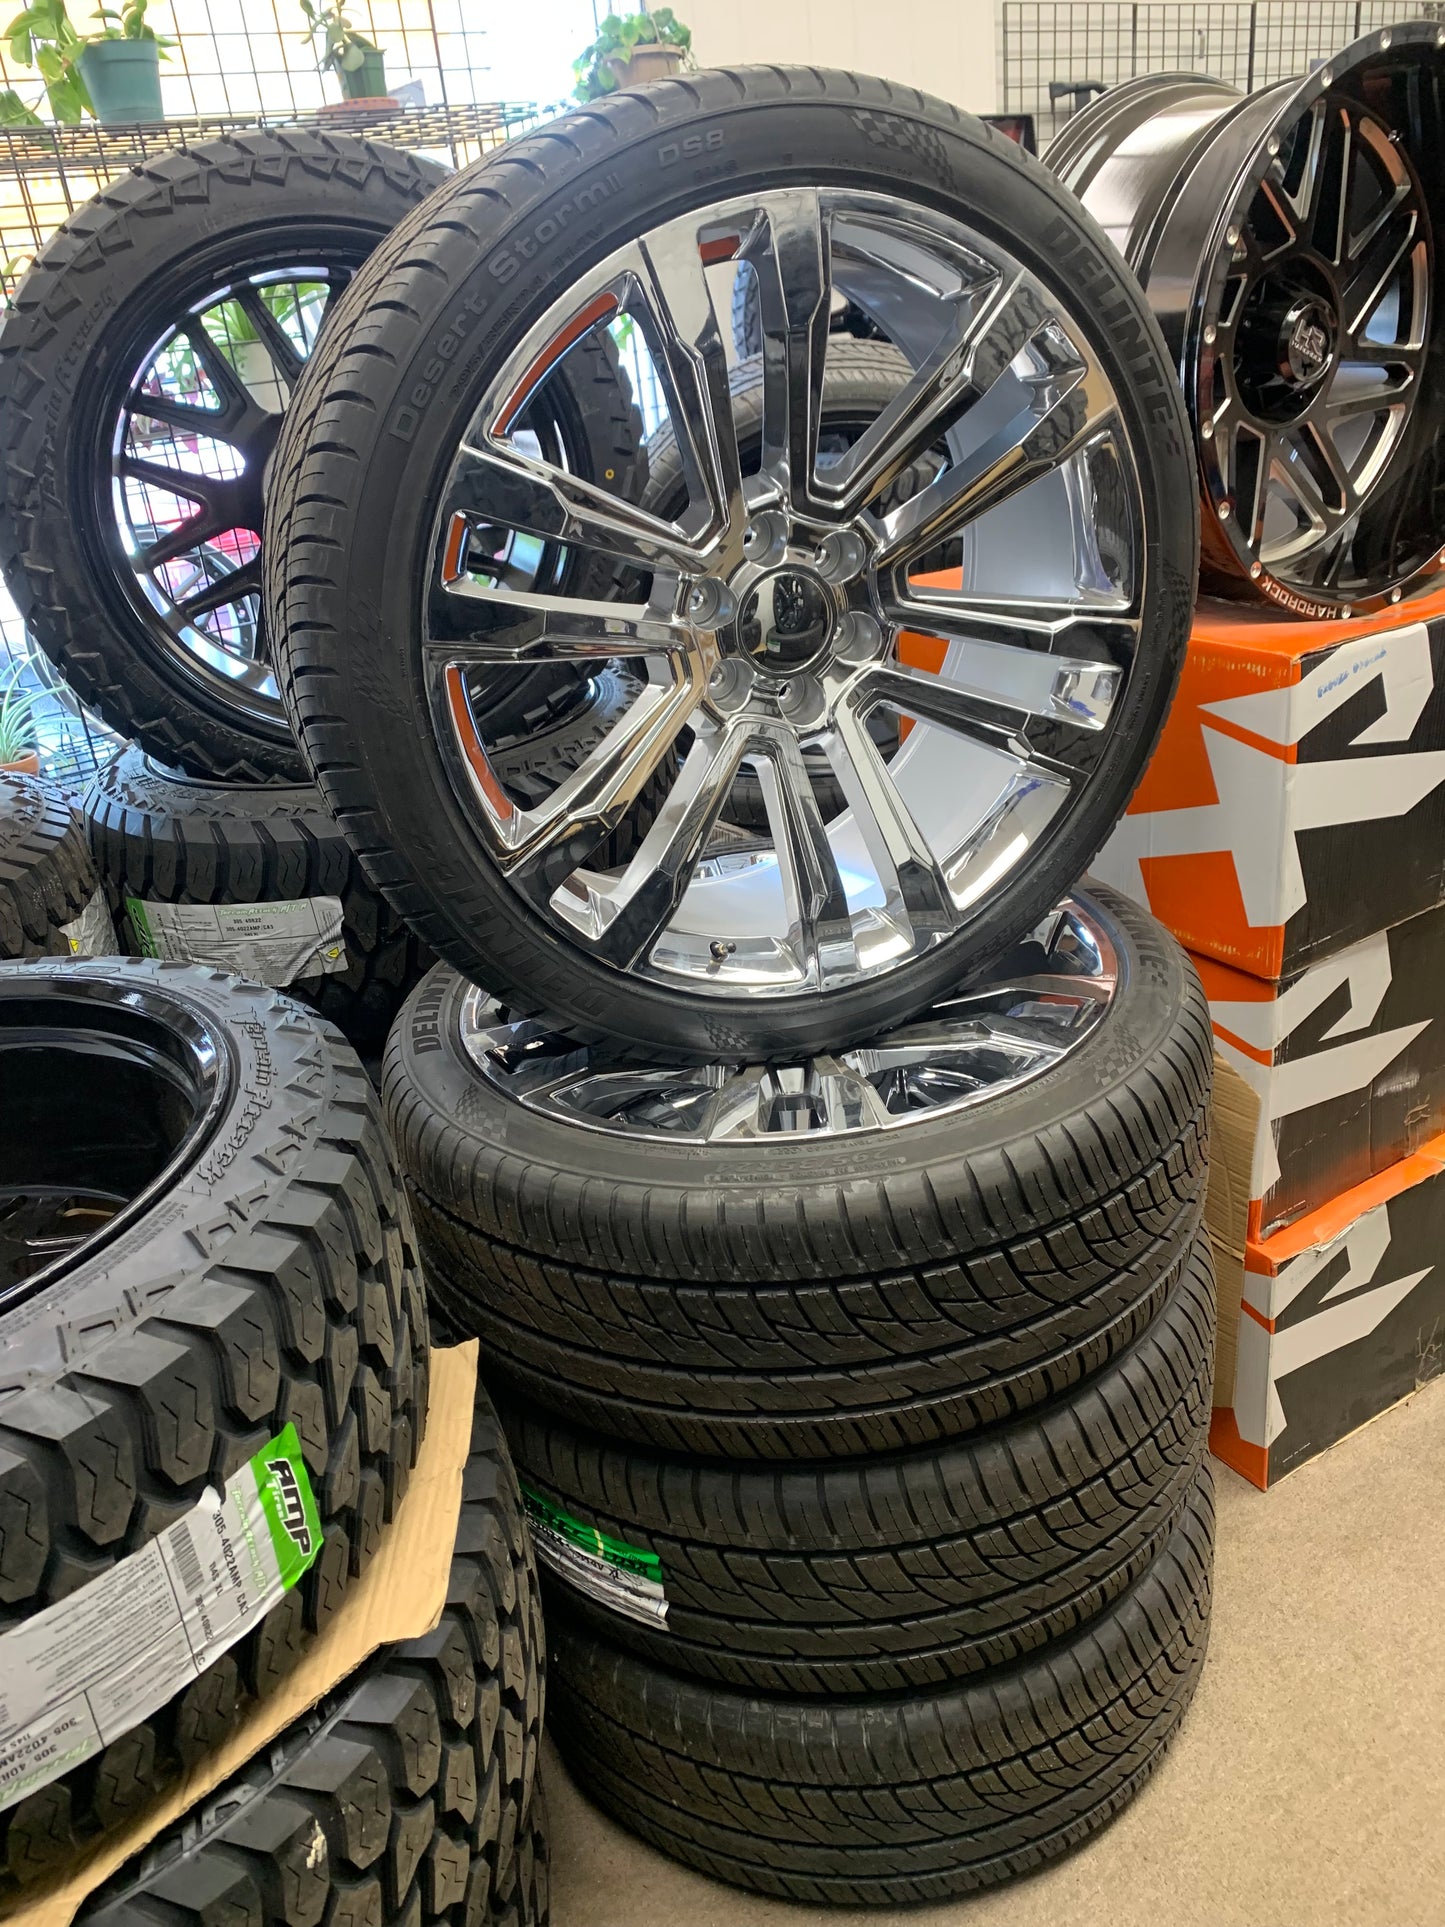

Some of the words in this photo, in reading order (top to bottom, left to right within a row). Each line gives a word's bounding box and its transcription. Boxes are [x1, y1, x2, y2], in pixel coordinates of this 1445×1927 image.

[658, 128, 725, 168] DS8
[388, 292, 488, 443] Desert
[488, 180, 609, 285] Storm
[1038, 215, 1175, 425] DELINTE
[1261, 575, 1337, 619] HARDROCK
[716, 1149, 891, 1173] 295/35R24
[264, 1457, 313, 1556] AMP
[266, 1477, 284, 1519] Tires
